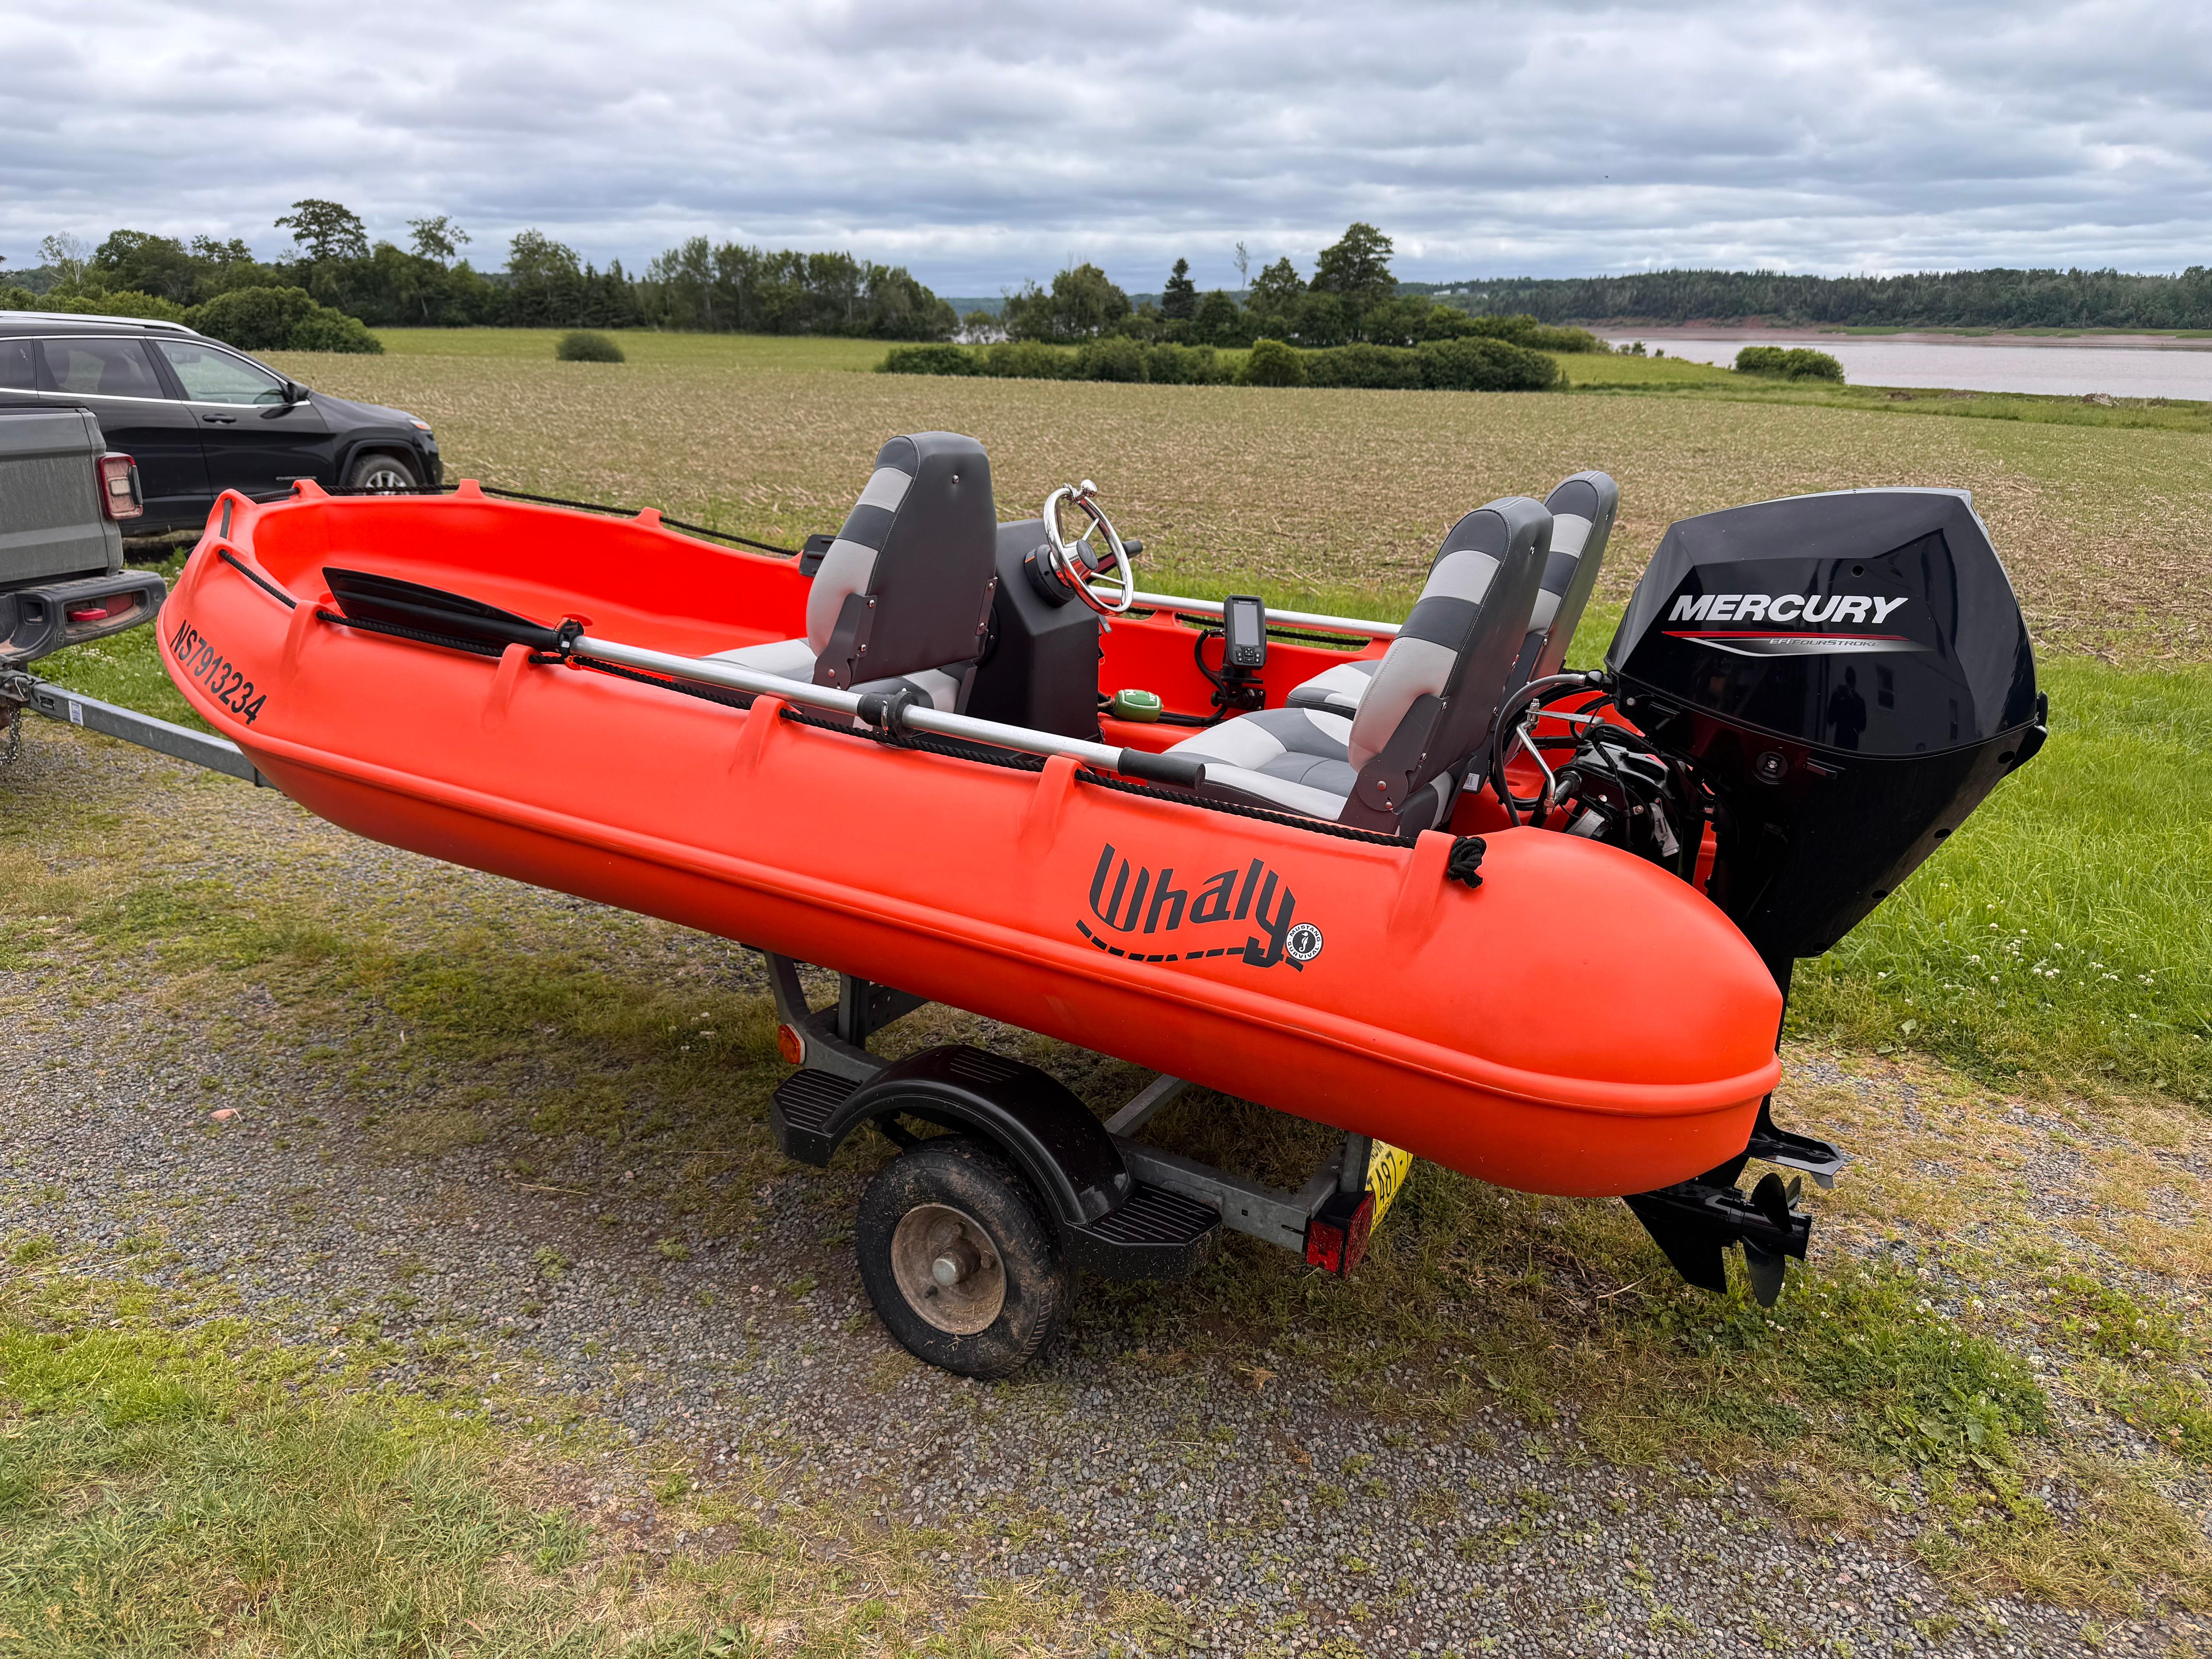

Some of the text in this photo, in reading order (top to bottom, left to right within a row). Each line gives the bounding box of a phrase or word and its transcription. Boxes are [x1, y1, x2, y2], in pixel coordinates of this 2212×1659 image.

[1668, 594, 1908, 624] MERCURY
[170, 619, 267, 725] NS7913234
[1089, 843, 1296, 967] Whaly
[1290, 925, 1321, 941] MUSTANG
[1288, 941, 1319, 958] SURVIVAL
